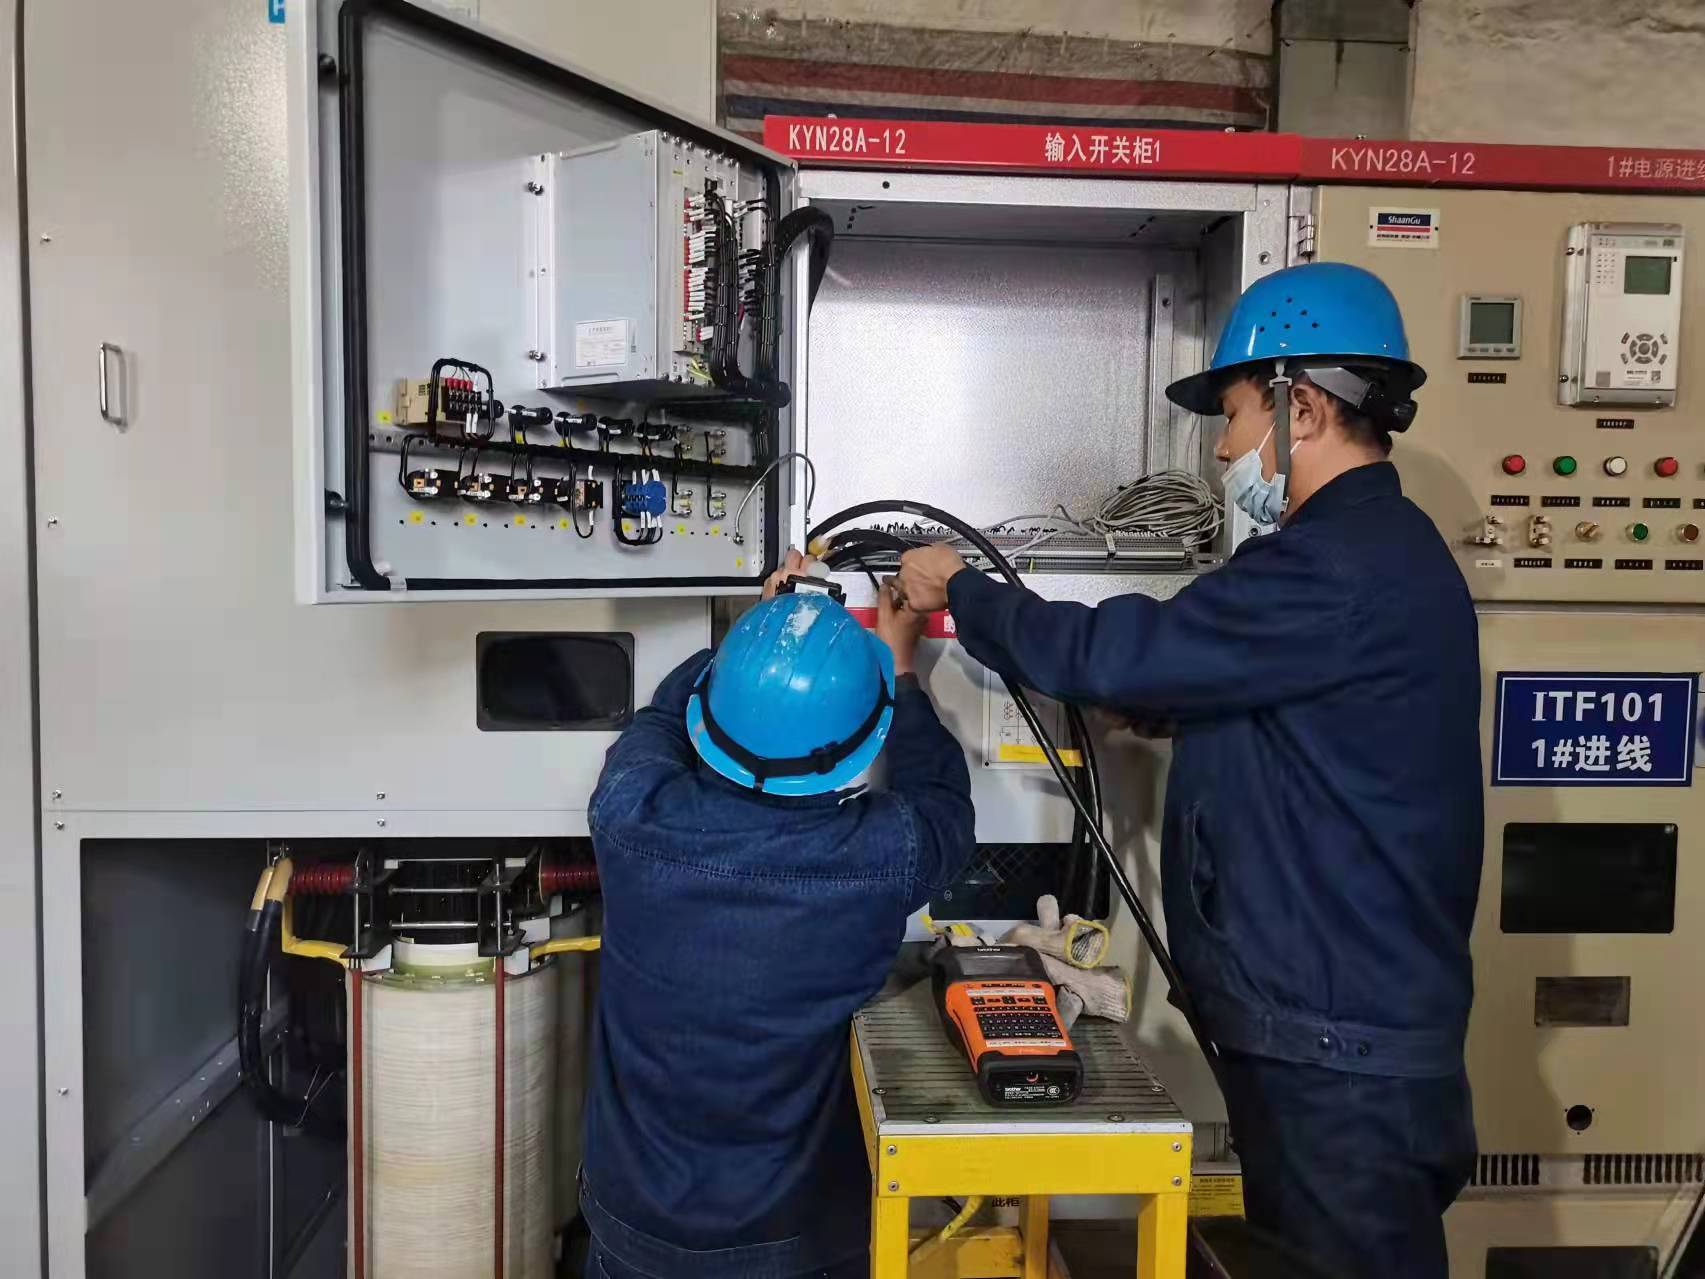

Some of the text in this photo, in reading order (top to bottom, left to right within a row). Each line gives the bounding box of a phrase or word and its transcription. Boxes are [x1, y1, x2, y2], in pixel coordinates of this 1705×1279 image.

[788, 124, 907, 155] KYN28A-12
[1044, 131, 1161, 165] 输入开关柜1
[1330, 147, 1477, 175] KYN28A-12
[1387, 215, 1421, 225] ShaanGu
[1531, 690, 1663, 722] ITF101
[1531, 734, 1653, 773] 1#进线
